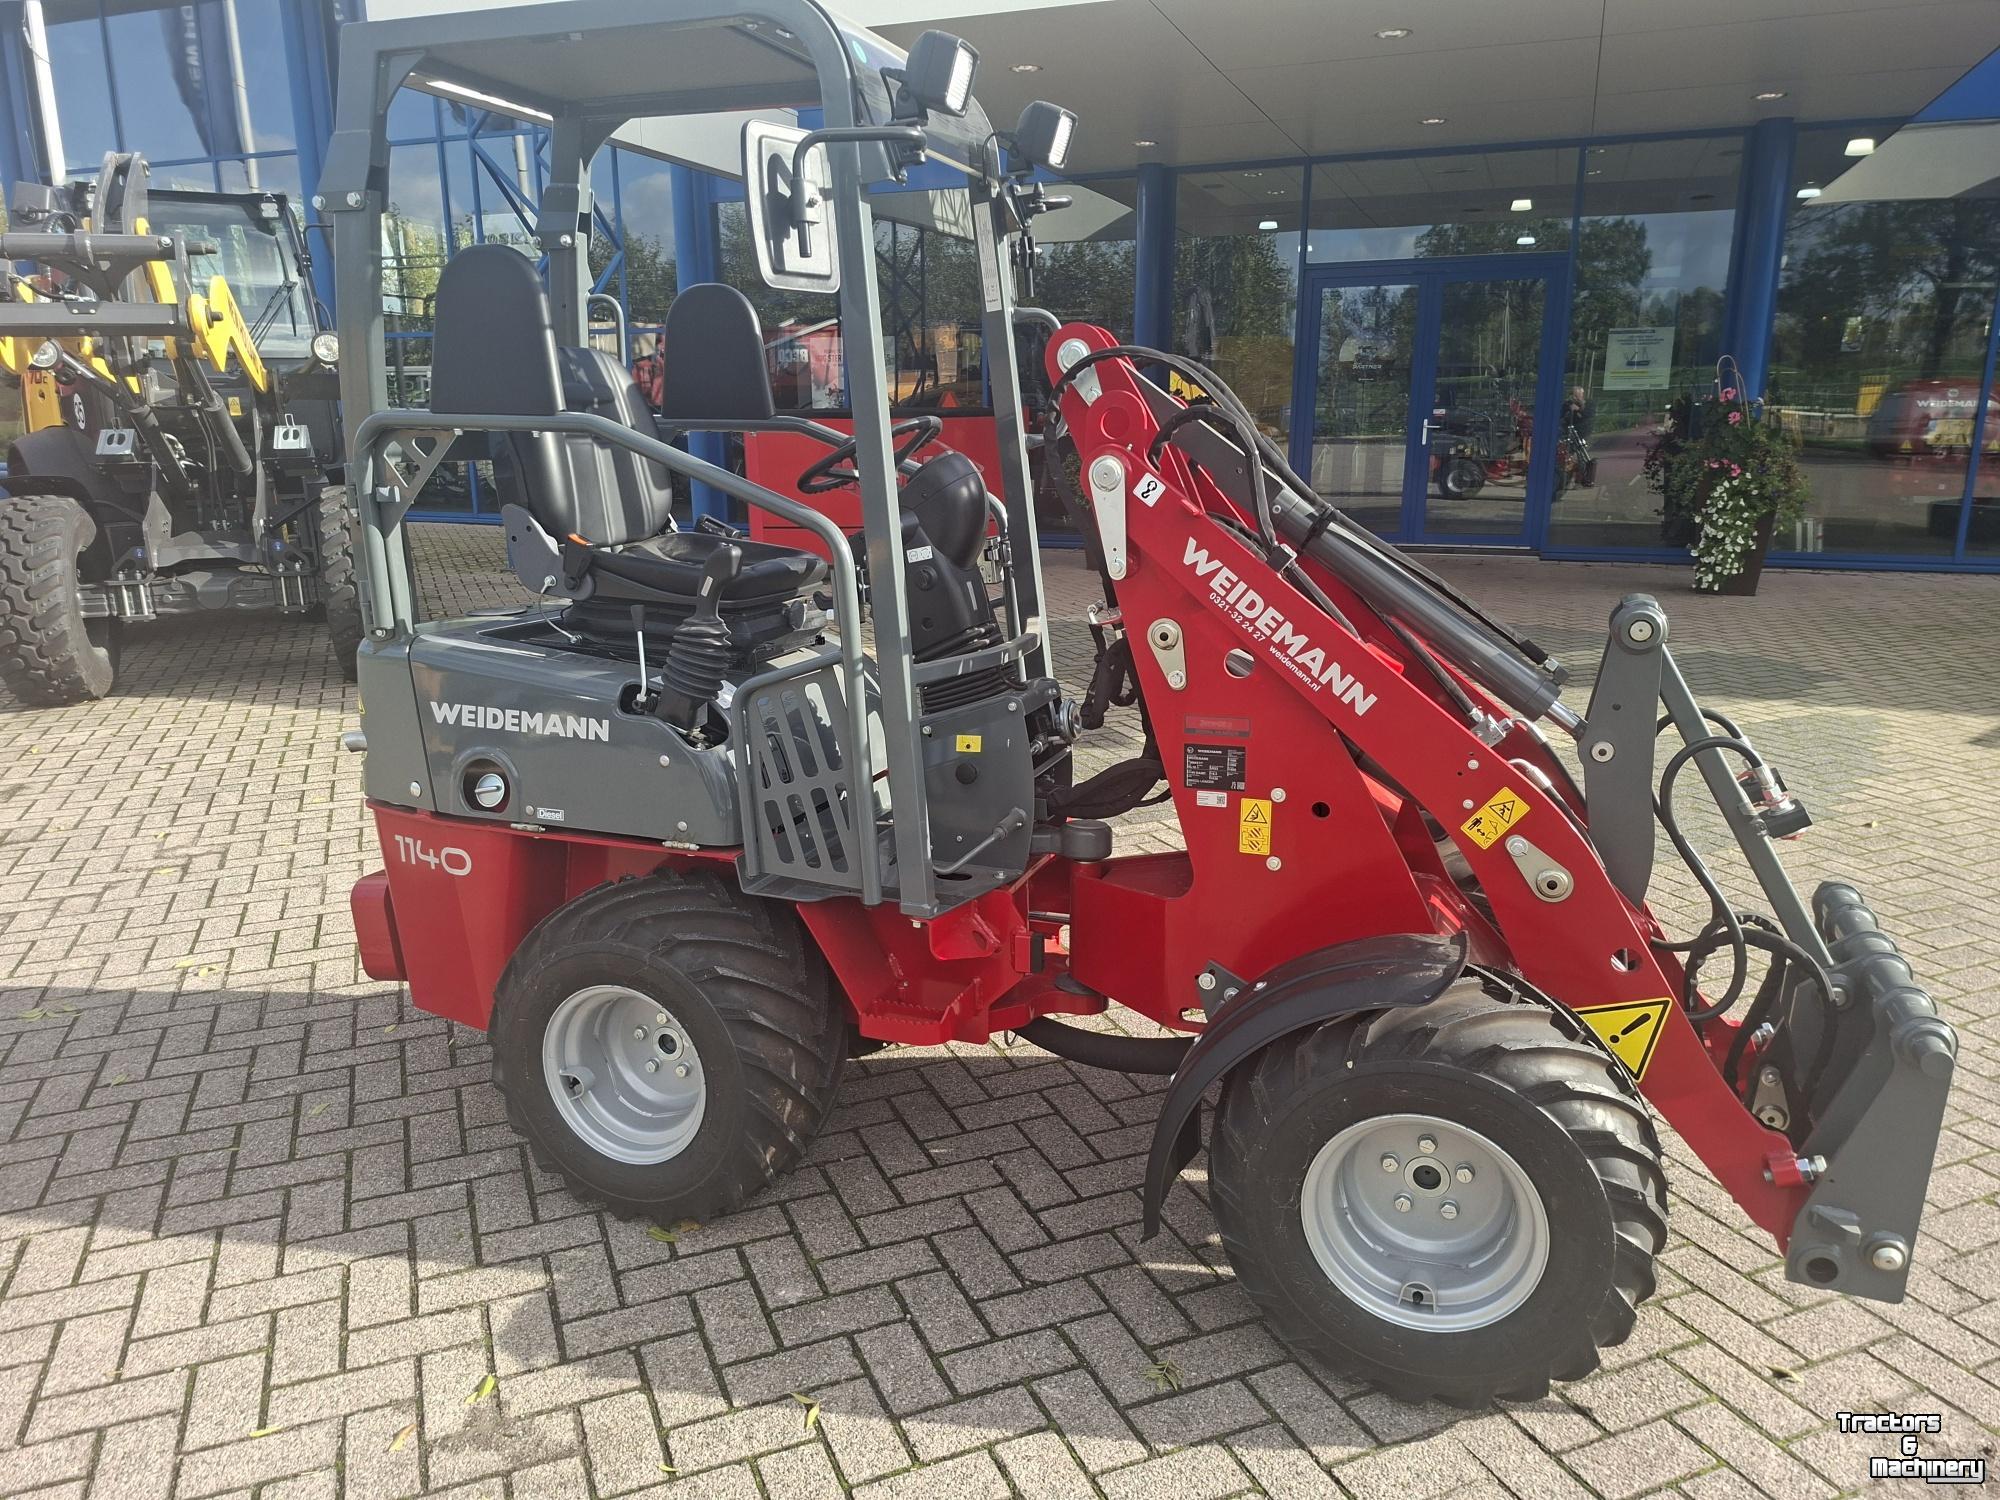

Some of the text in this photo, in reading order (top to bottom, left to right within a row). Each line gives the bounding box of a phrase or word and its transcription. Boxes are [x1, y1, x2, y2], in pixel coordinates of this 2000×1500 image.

[1183, 536, 1378, 717] WEIDEMANN
[1209, 592, 1322, 692] 0321-32 24 27 weidemann.nl
[430, 701, 610, 742] WEIDEMANN
[539, 809, 562, 820] Diesel
[394, 834, 472, 876] 1140
